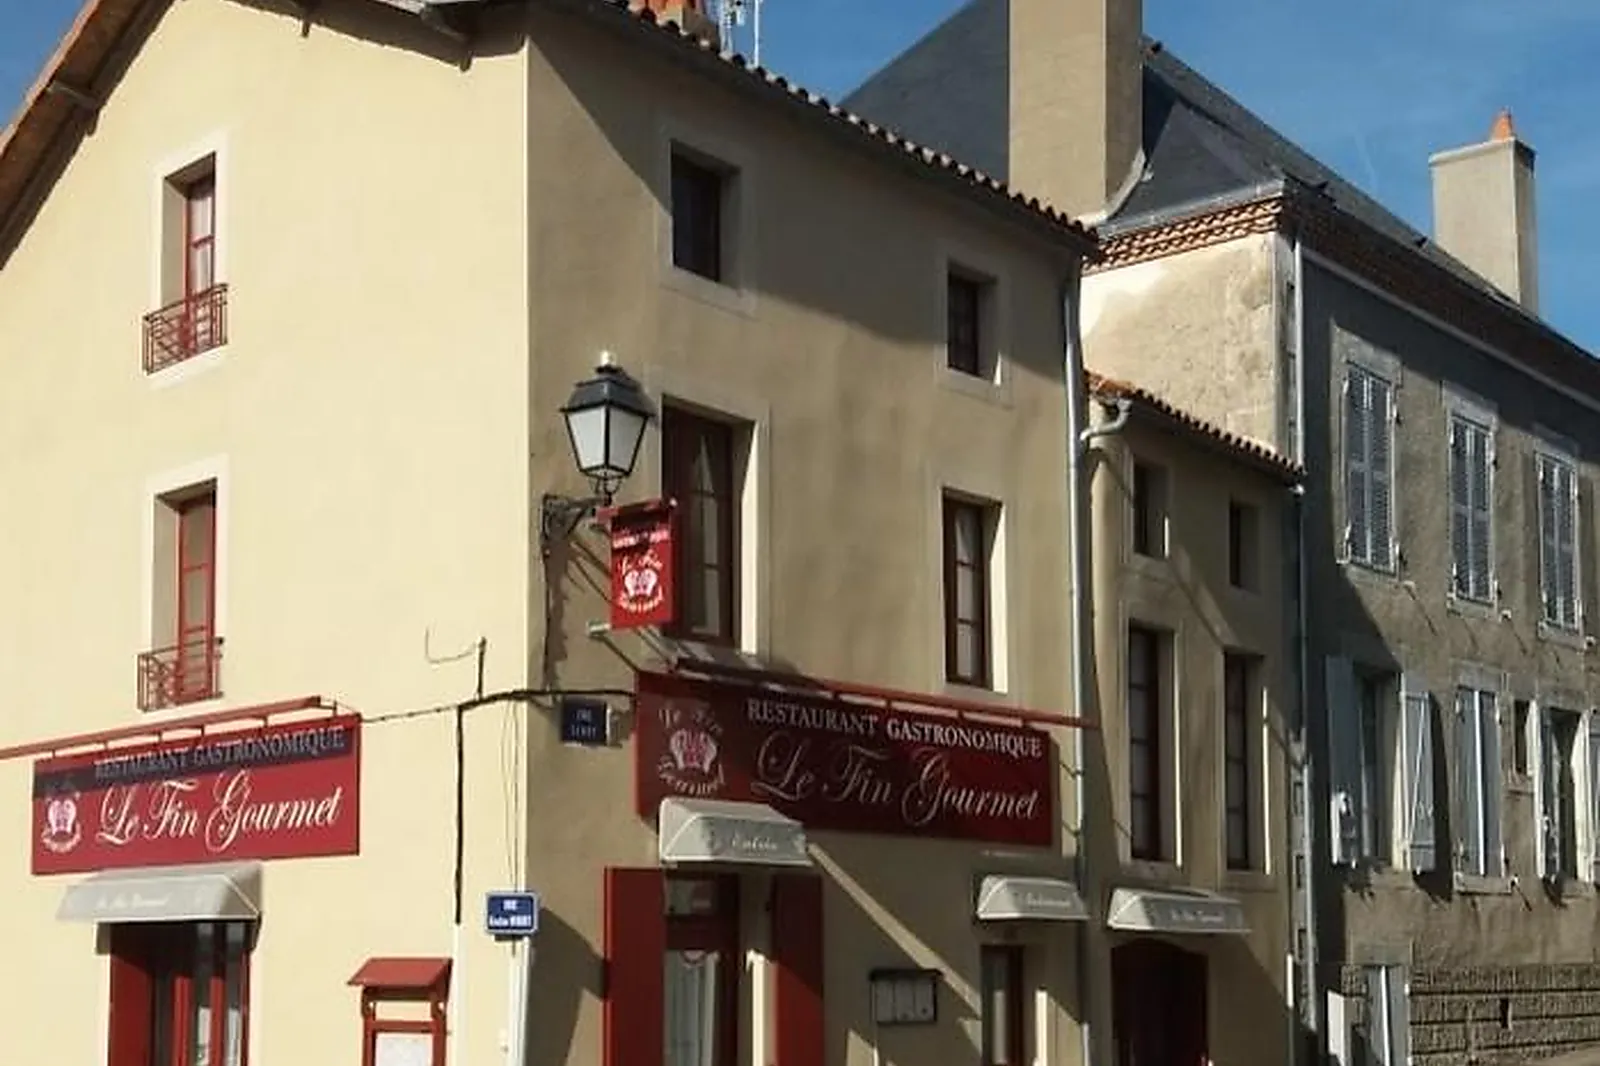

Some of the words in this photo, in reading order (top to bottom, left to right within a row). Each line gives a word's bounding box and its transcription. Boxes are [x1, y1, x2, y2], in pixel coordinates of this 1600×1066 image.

[94, 748, 191, 781] RESTAURANT
[193, 725, 346, 768] GASTRONOMIQUE
[746, 698, 879, 738] RESTAURANT
[886, 718, 1042, 759] GASTRONOMIQUE
[95, 784, 138, 846] Le
[143, 780, 201, 841] Fin
[205, 769, 343, 854] Gourmet
[750, 730, 816, 802] Le
[822, 743, 893, 806] Fin
[901, 746, 1041, 826] Gourmet
